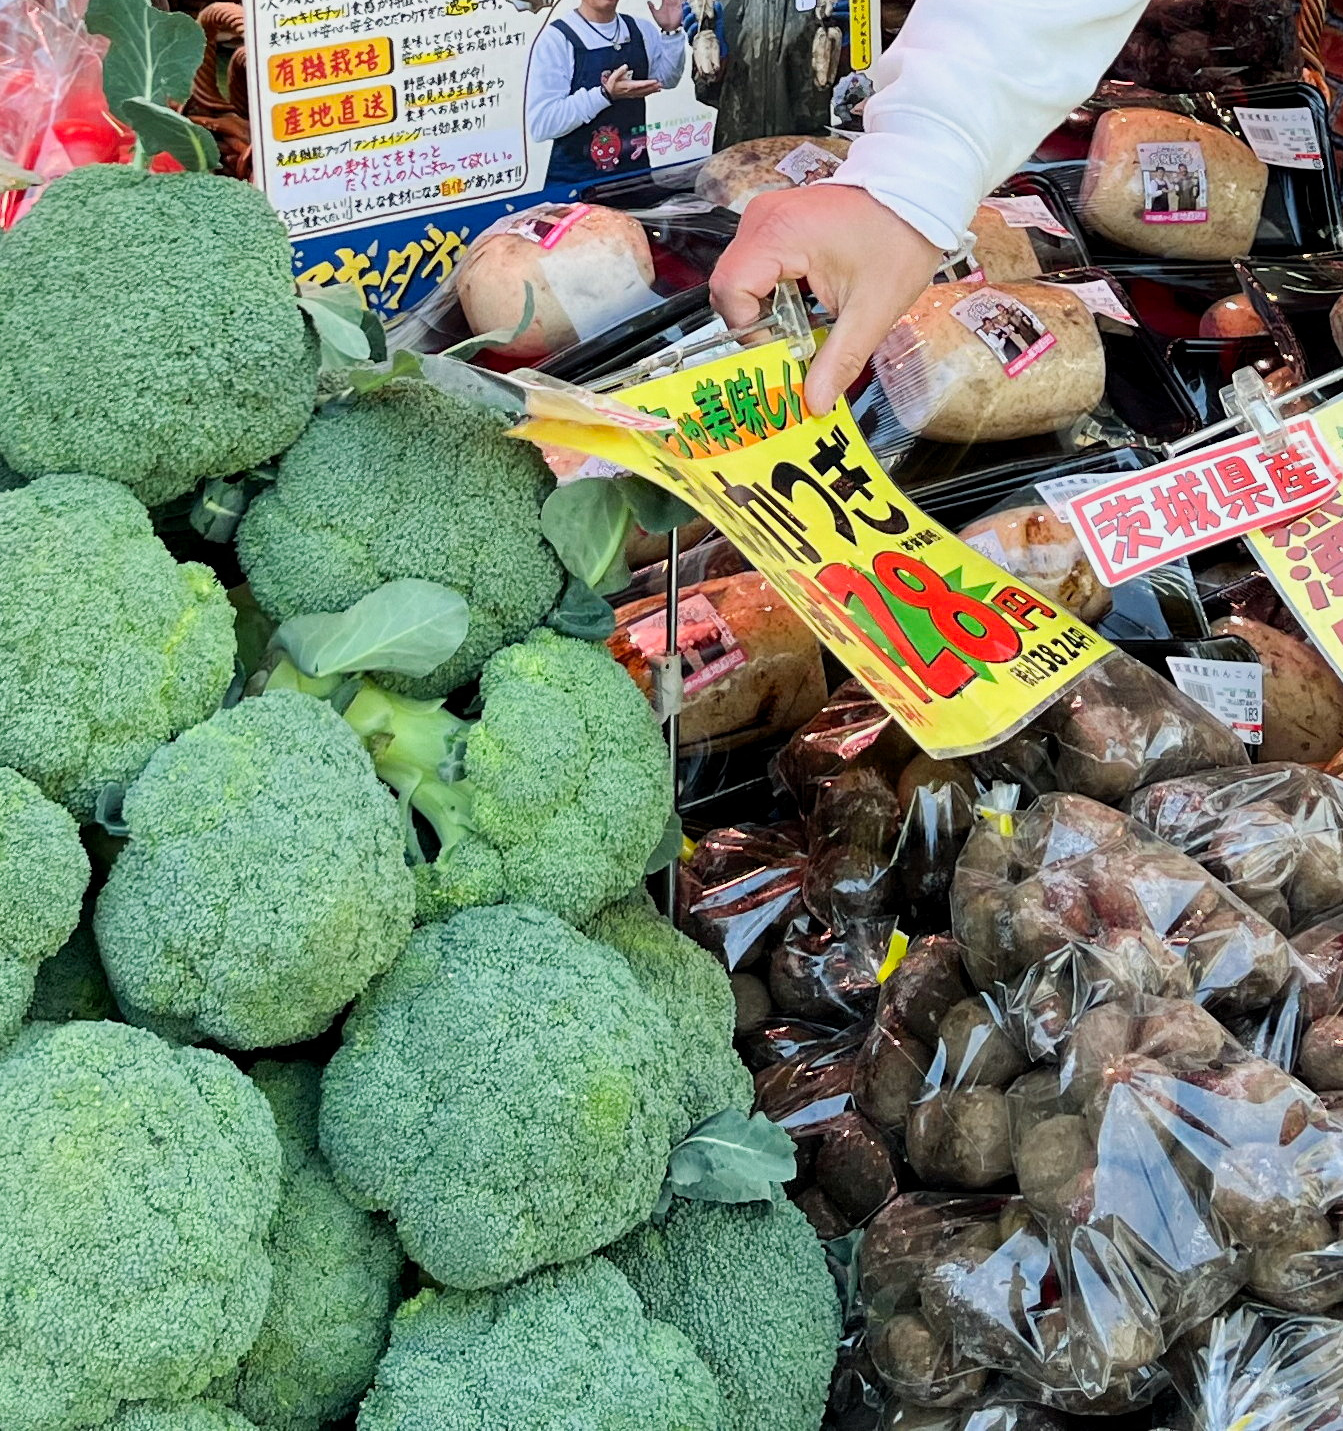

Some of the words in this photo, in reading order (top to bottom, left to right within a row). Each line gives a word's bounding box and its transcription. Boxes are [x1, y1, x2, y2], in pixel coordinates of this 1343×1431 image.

[401, 23, 508, 51] 美味しさだけじゃない!
[273, 42, 382, 88] 有機栽培
[283, 89, 390, 137] 産地直送
[629, 121, 714, 161] アキダイ
[281, 145, 442, 188] れんこんの美味しさをもっと
[345, 150, 514, 193] たくさんの人に知って欲しい。
[296, 226, 471, 310] アキダイ
[1090, 443, 1332, 567] 茨城県産
[788, 549, 1027, 706] 128
[989, 584, 1057, 635] 円
